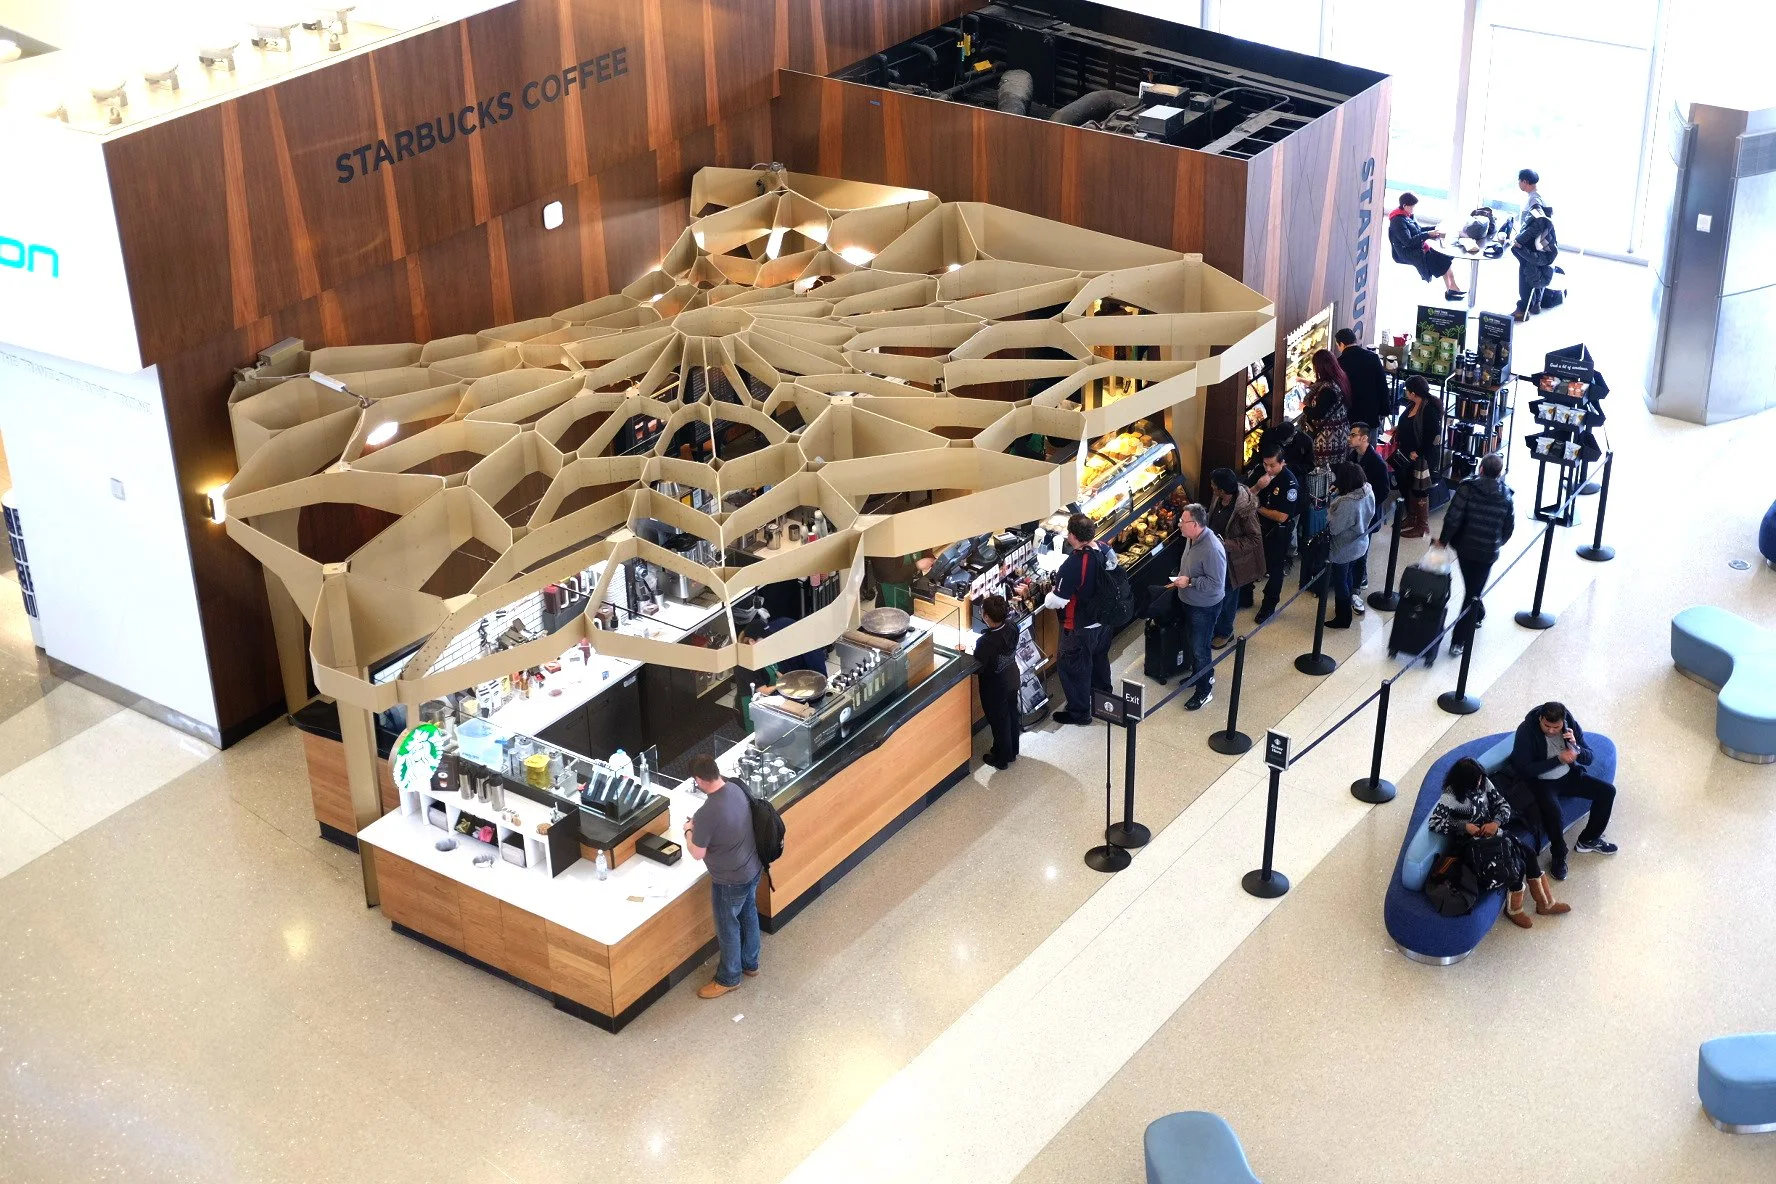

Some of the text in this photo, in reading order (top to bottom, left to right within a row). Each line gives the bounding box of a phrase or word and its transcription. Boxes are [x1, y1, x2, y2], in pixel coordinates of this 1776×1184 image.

[335, 47, 628, 184] STARBUCKS COFFEE
[1352, 156, 1375, 342] STARBUC
[1125, 693, 1140, 706] Exit
